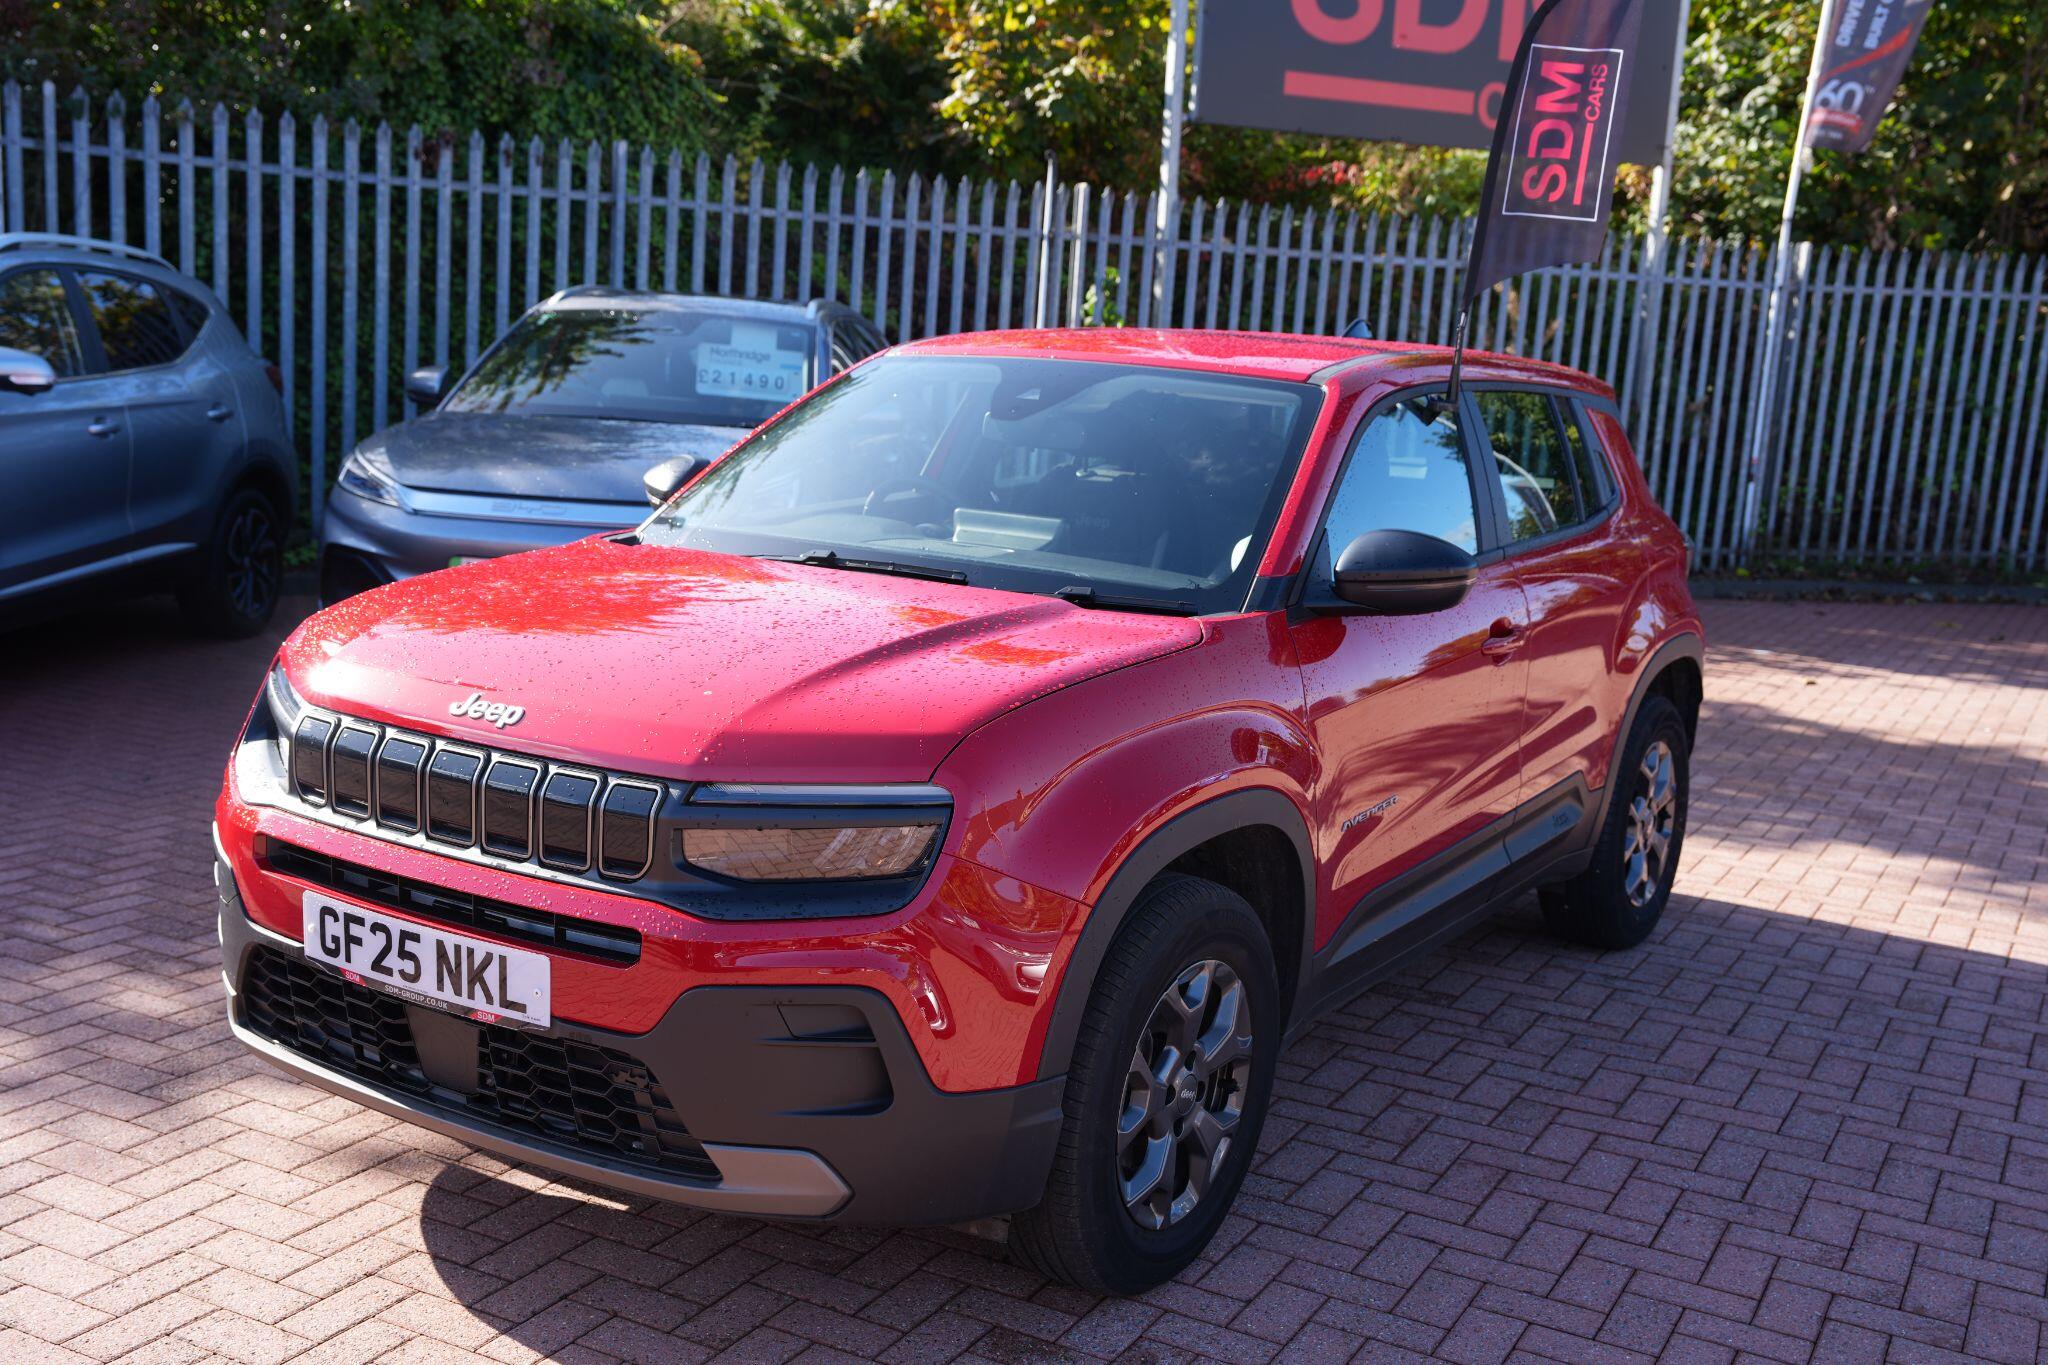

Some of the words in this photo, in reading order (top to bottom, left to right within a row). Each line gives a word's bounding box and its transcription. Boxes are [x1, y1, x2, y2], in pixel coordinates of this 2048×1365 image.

[1584, 63, 1608, 122] CARS
[1521, 60, 1585, 203] SDM
[698, 369, 785, 390] £21490
[449, 692, 526, 729] Jeep
[1341, 793, 1399, 832] AVENGER
[319, 905, 422, 984] GF25
[435, 938, 528, 1014] NKL
[344, 970, 361, 983] SDM
[384, 984, 448, 1010] SDM-GROUP.CO.UK
[477, 1011, 495, 1022] SDM
